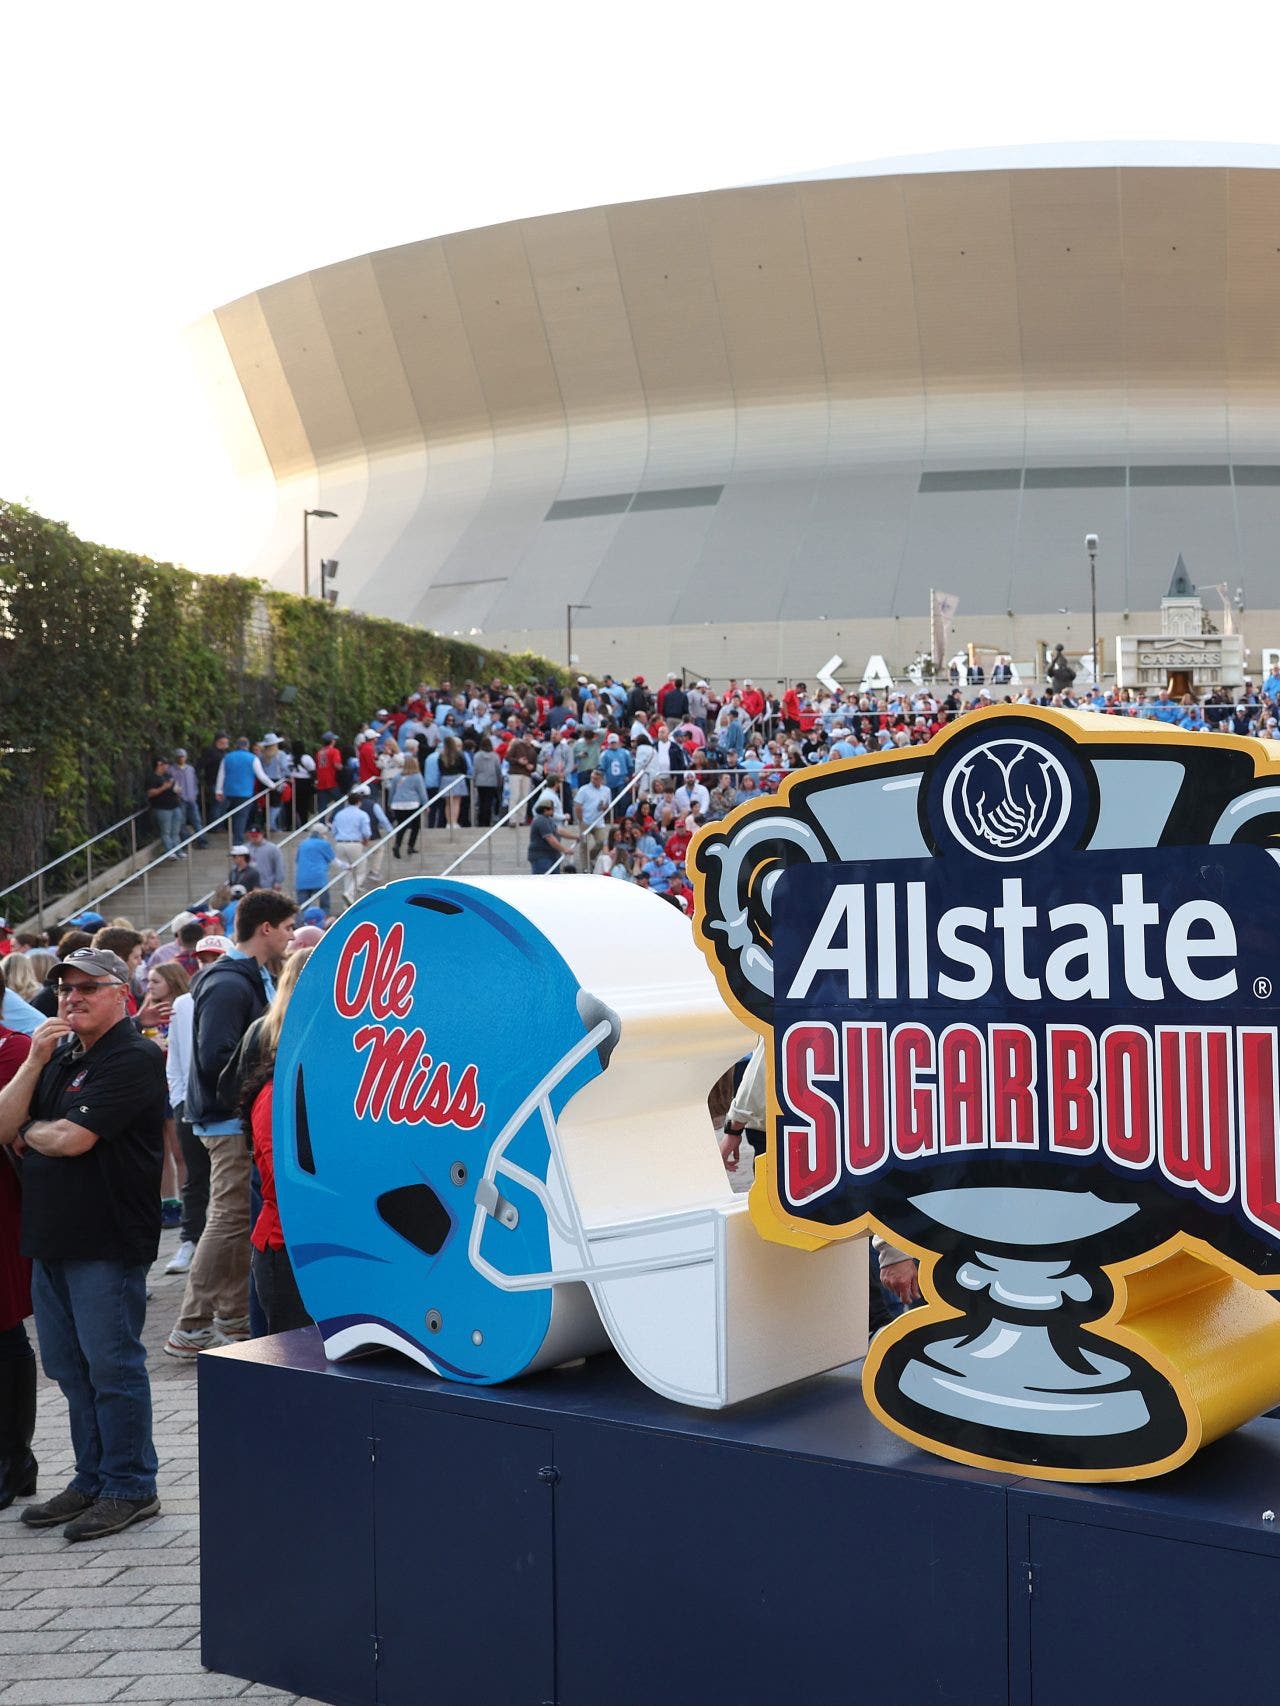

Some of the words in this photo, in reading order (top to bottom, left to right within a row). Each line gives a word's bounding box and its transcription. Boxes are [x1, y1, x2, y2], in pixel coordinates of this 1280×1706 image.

[1140, 653, 1221, 665] CAESARS
[611, 760, 621, 776] 6
[334, 921, 416, 1021] Ole
[787, 874, 1238, 1001] Allstate
[353, 1024, 485, 1130] Miss
[782, 1021, 1039, 1206] SUGAR
